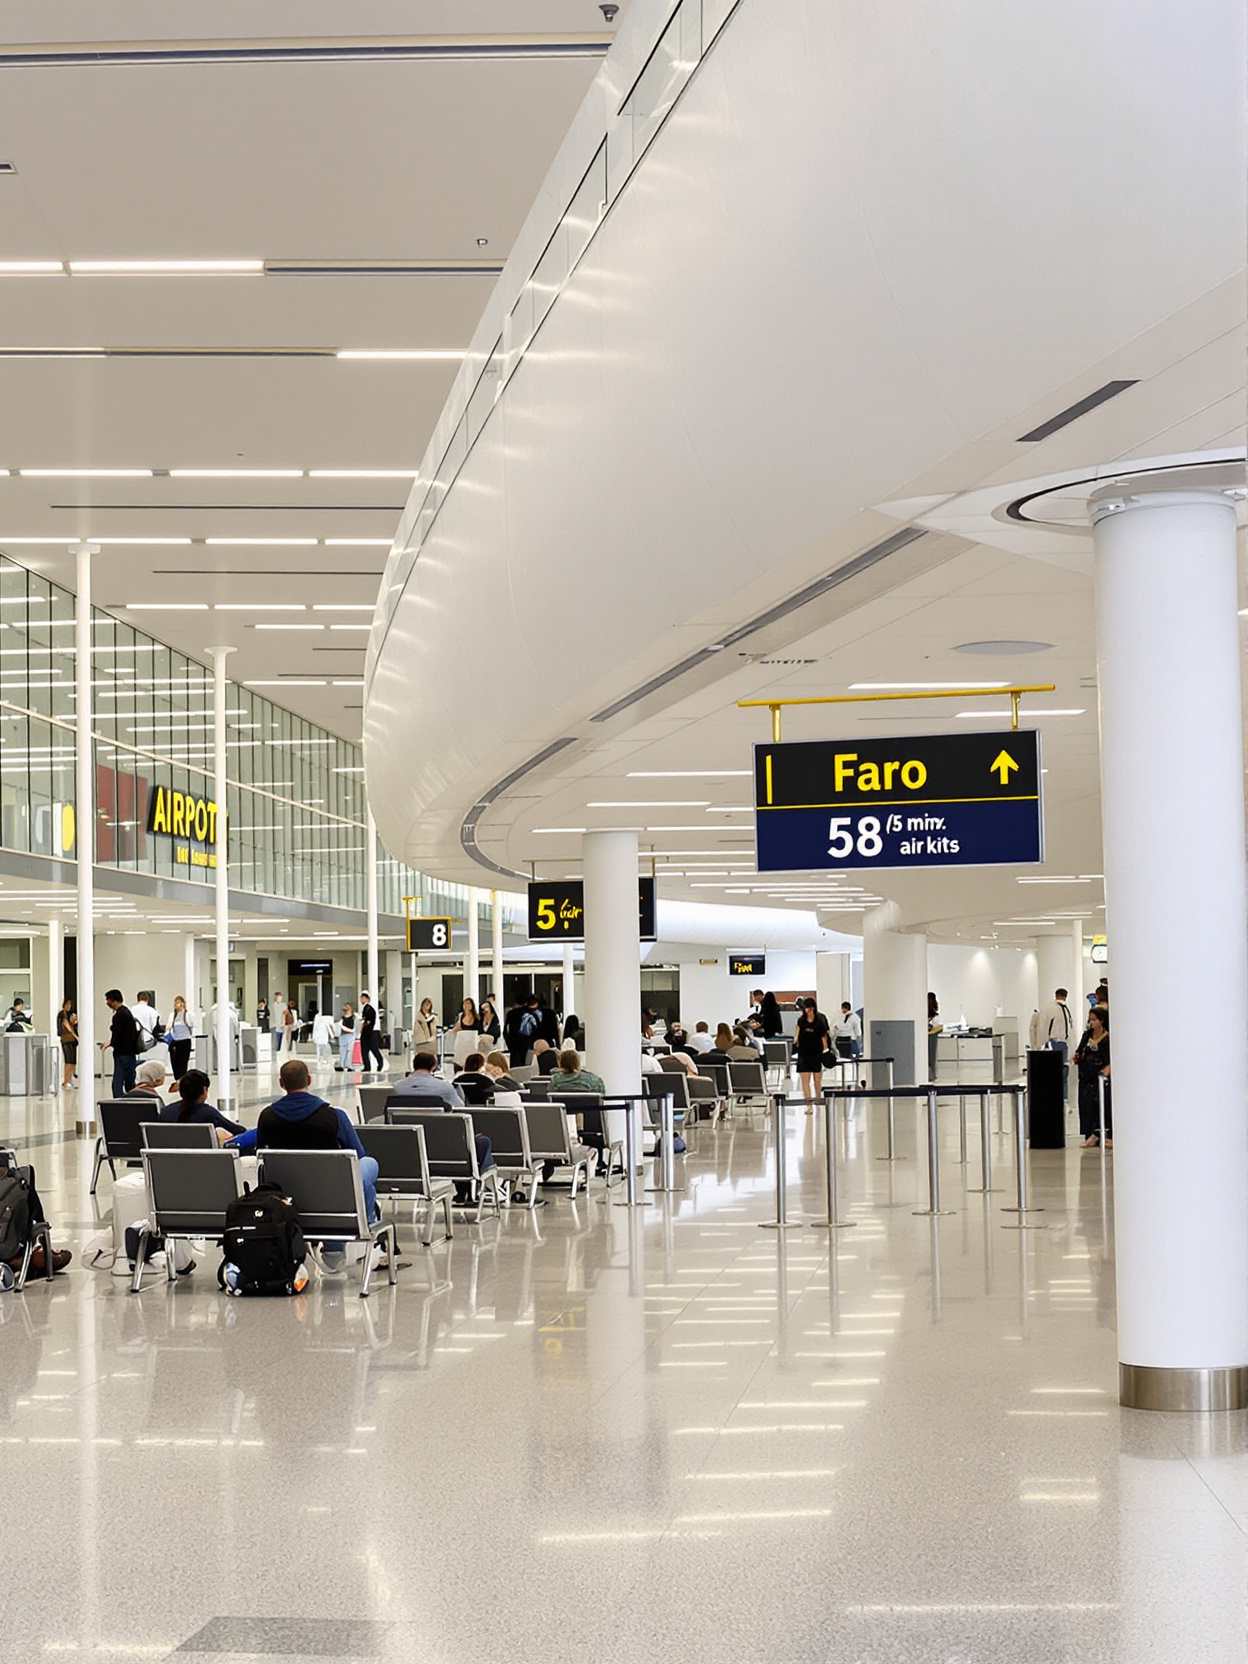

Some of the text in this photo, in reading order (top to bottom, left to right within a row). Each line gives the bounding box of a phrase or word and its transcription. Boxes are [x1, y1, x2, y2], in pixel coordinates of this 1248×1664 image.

[834, 753, 927, 792] Faro
[153, 786, 219, 844] AIRPOT
[827, 816, 883, 858] 58
[900, 836, 960, 855] air kits
[536, 898, 556, 930] 5
[432, 923, 447, 946] 8
